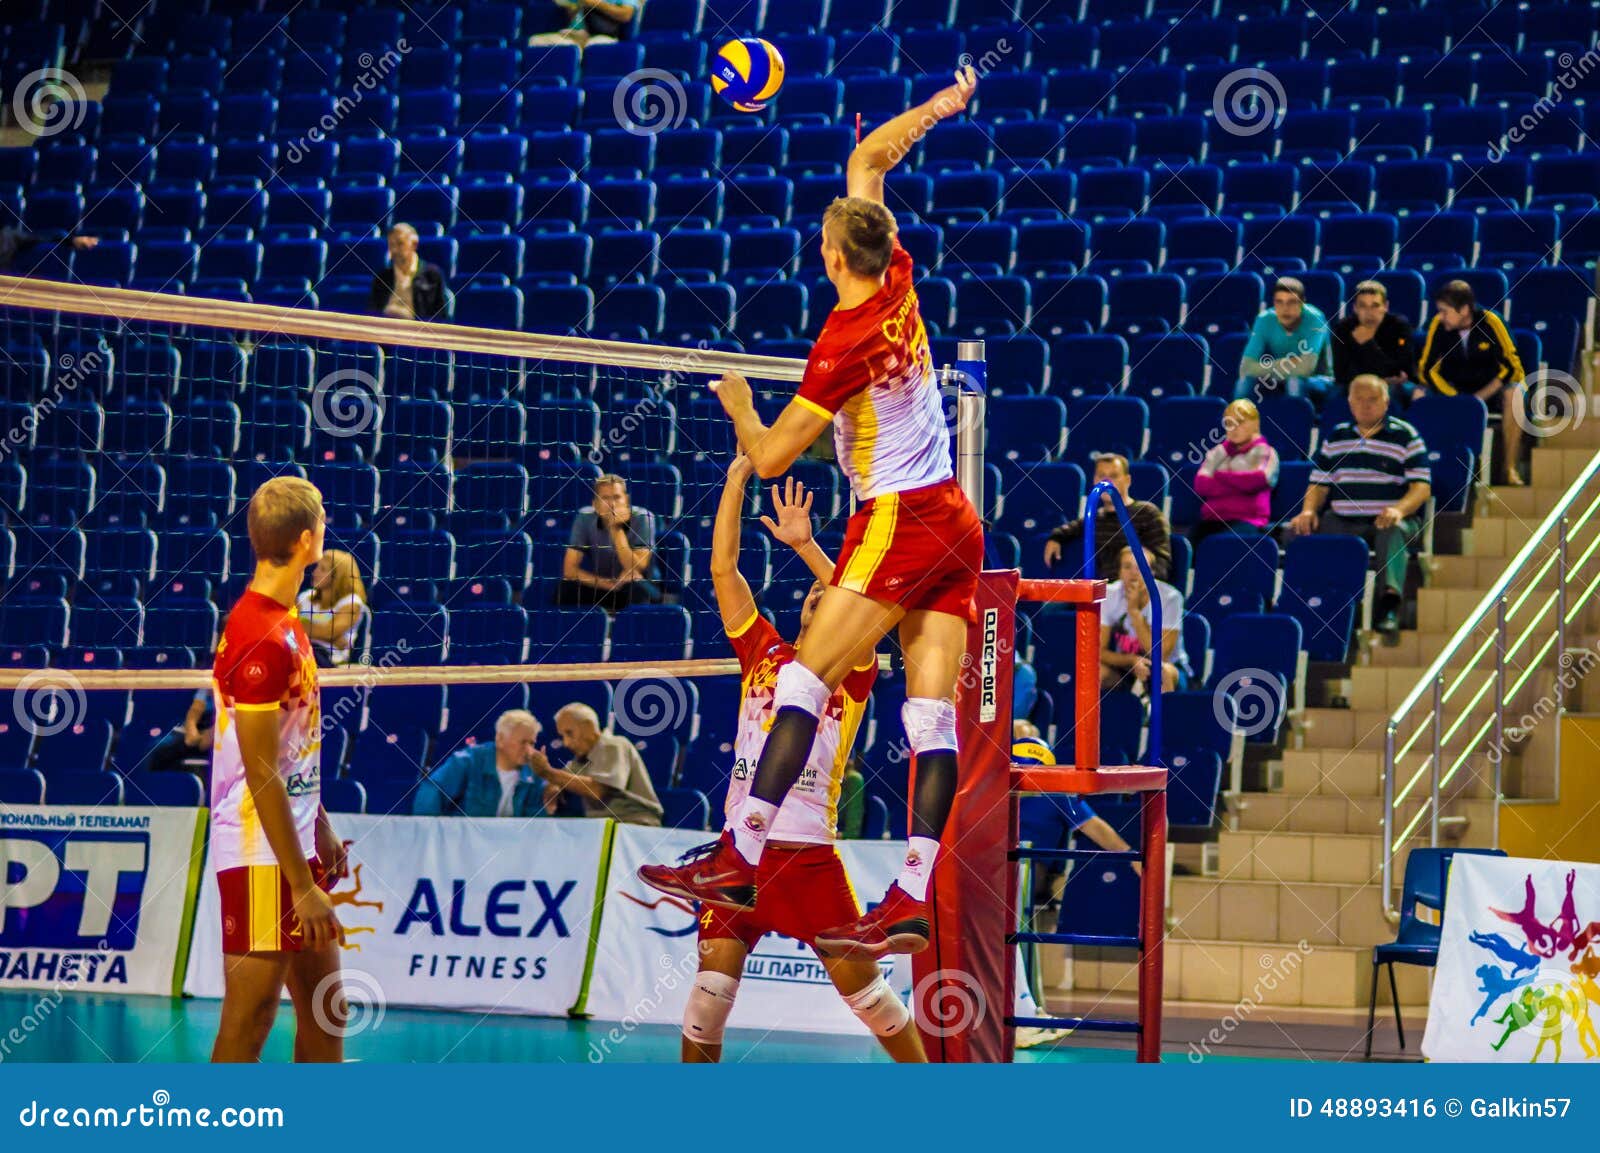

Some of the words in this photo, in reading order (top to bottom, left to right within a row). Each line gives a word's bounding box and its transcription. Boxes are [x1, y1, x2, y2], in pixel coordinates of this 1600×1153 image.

[80, 816, 150, 827] ТЕЛЕКАНАЛ
[394, 878, 577, 937] ALEX
[700, 909, 714, 929] 4
[409, 954, 547, 979] FITNESS
